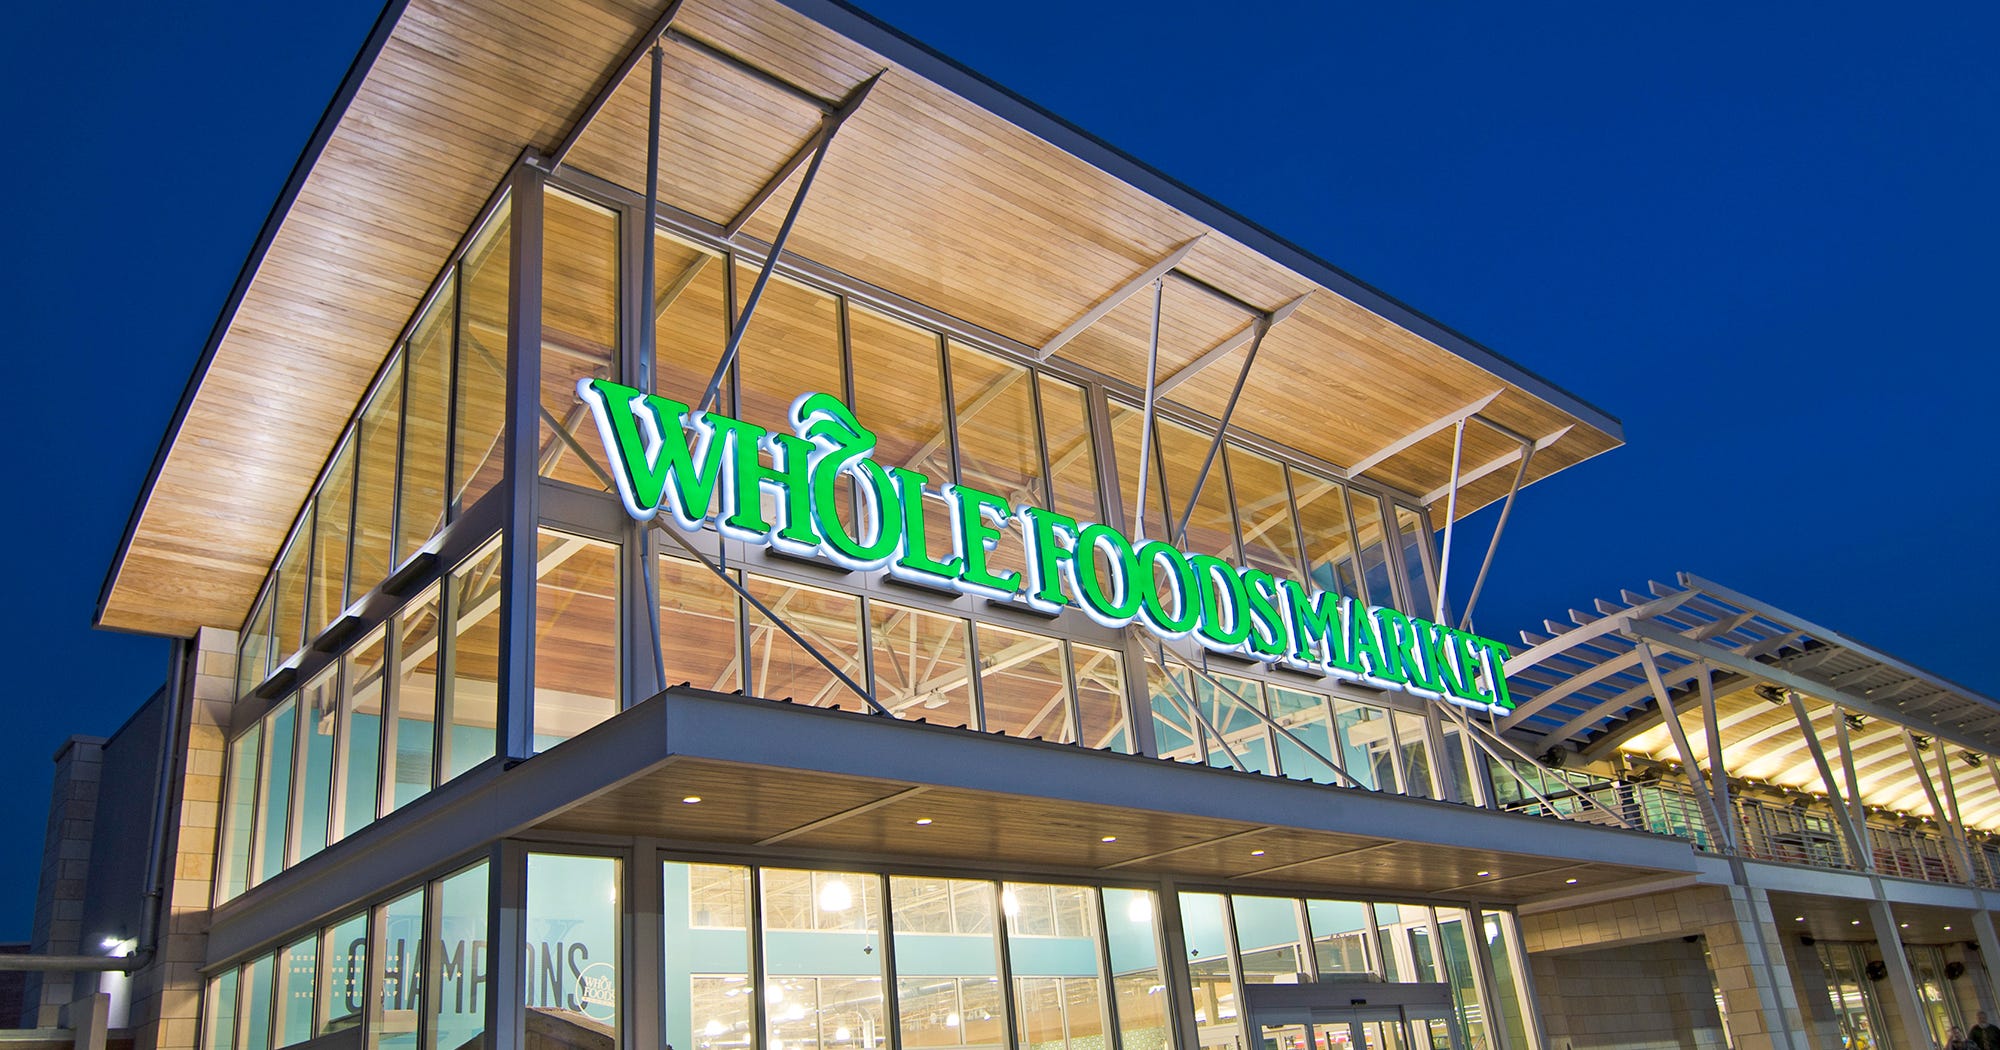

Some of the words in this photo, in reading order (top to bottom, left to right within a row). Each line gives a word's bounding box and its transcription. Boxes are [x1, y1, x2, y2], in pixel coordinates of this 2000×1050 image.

[578, 377, 1023, 601] WHOLE
[1014, 505, 1290, 658] FOODS
[1281, 578, 1517, 716] MARKET
[345, 937, 589, 1014] CHAMPONS
[584, 975, 615, 992] WHOL
